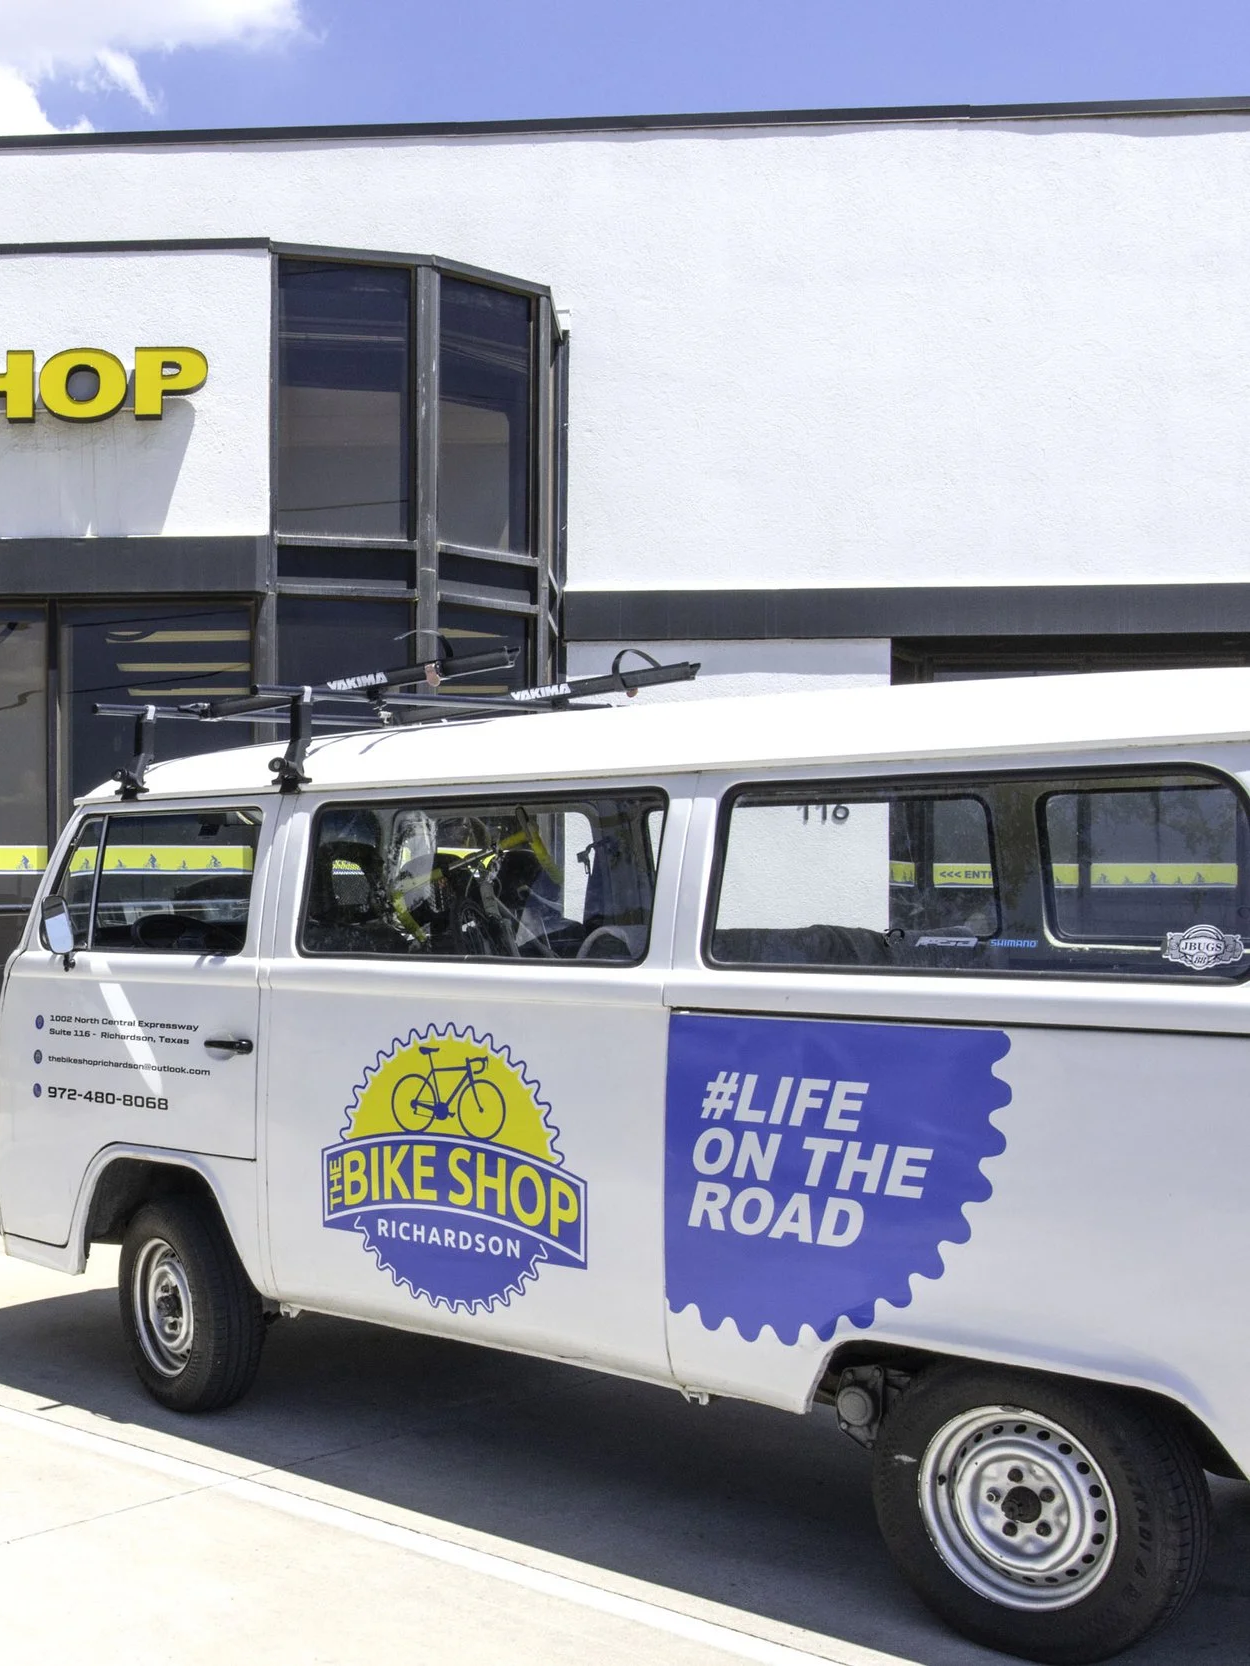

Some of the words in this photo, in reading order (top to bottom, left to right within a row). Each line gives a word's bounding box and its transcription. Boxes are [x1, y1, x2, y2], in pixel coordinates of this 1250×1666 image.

[327, 672, 388, 691] YAKIMA
[510, 683, 571, 700] YAKIMA
[990, 939, 1037, 948] SHIMANO
[1181, 941, 1223, 952] JBUGS
[50, 1015, 73, 1023] 1002
[74, 1016, 100, 1025] North
[101, 1018, 136, 1027] Central
[138, 1020, 199, 1032] Expressway
[49, 1028, 72, 1036] Suite
[73, 1030, 91, 1038] 116
[100, 1031, 156, 1043] Richardson,
[158, 1035, 190, 1045] Texas
[48, 1055, 211, 1076] thebikeshoprichardson@outlook.com
[48, 1086, 169, 1111] 972-480-8068
[700, 1071, 869, 1132] #LIFE
[692, 1127, 782, 1182] ON
[802, 1136, 934, 1199] THE
[329, 1156, 342, 1210] THE
[343, 1144, 438, 1206] BIKE
[448, 1147, 579, 1238] SHOP
[688, 1181, 865, 1248] ROAD
[377, 1218, 520, 1259] RICHARDSON
